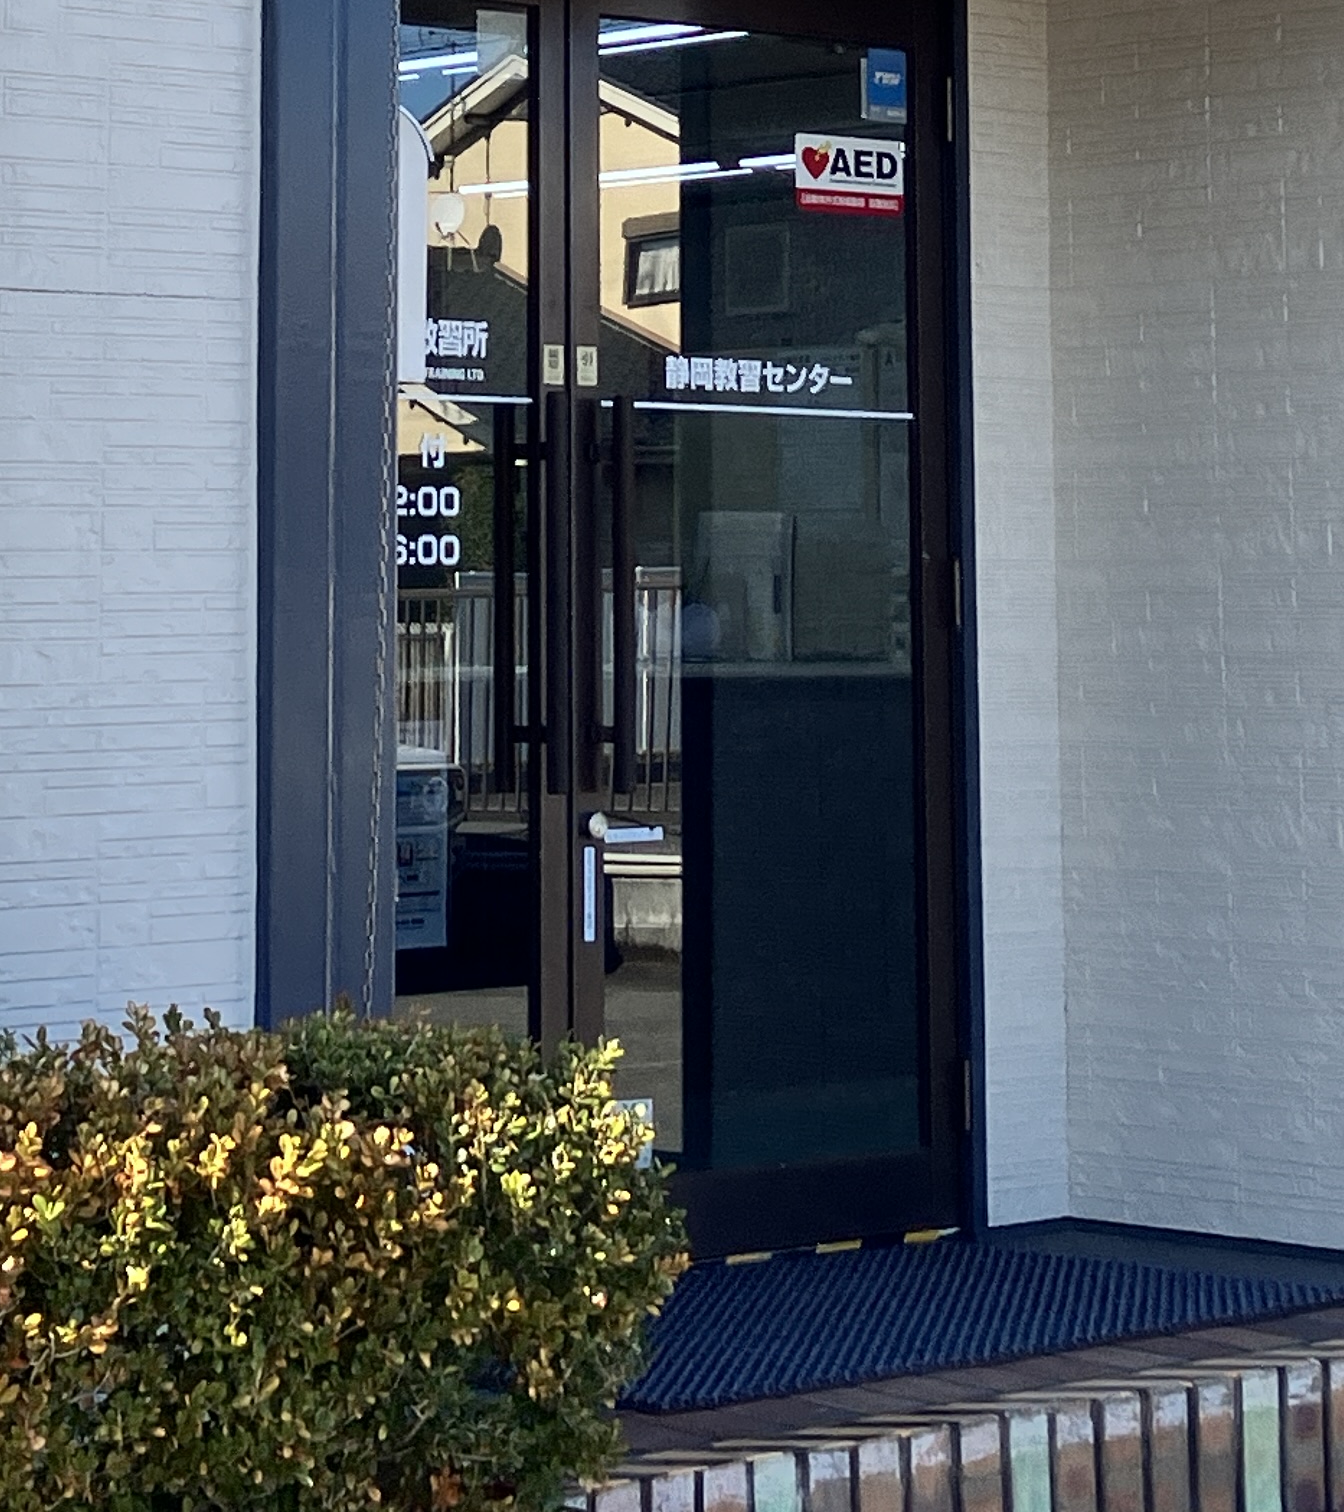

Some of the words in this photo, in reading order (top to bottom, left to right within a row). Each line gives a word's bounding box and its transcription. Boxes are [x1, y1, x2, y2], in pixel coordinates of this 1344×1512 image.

[830, 147, 898, 180] AED
[665, 354, 853, 394] 静岡教習センター
